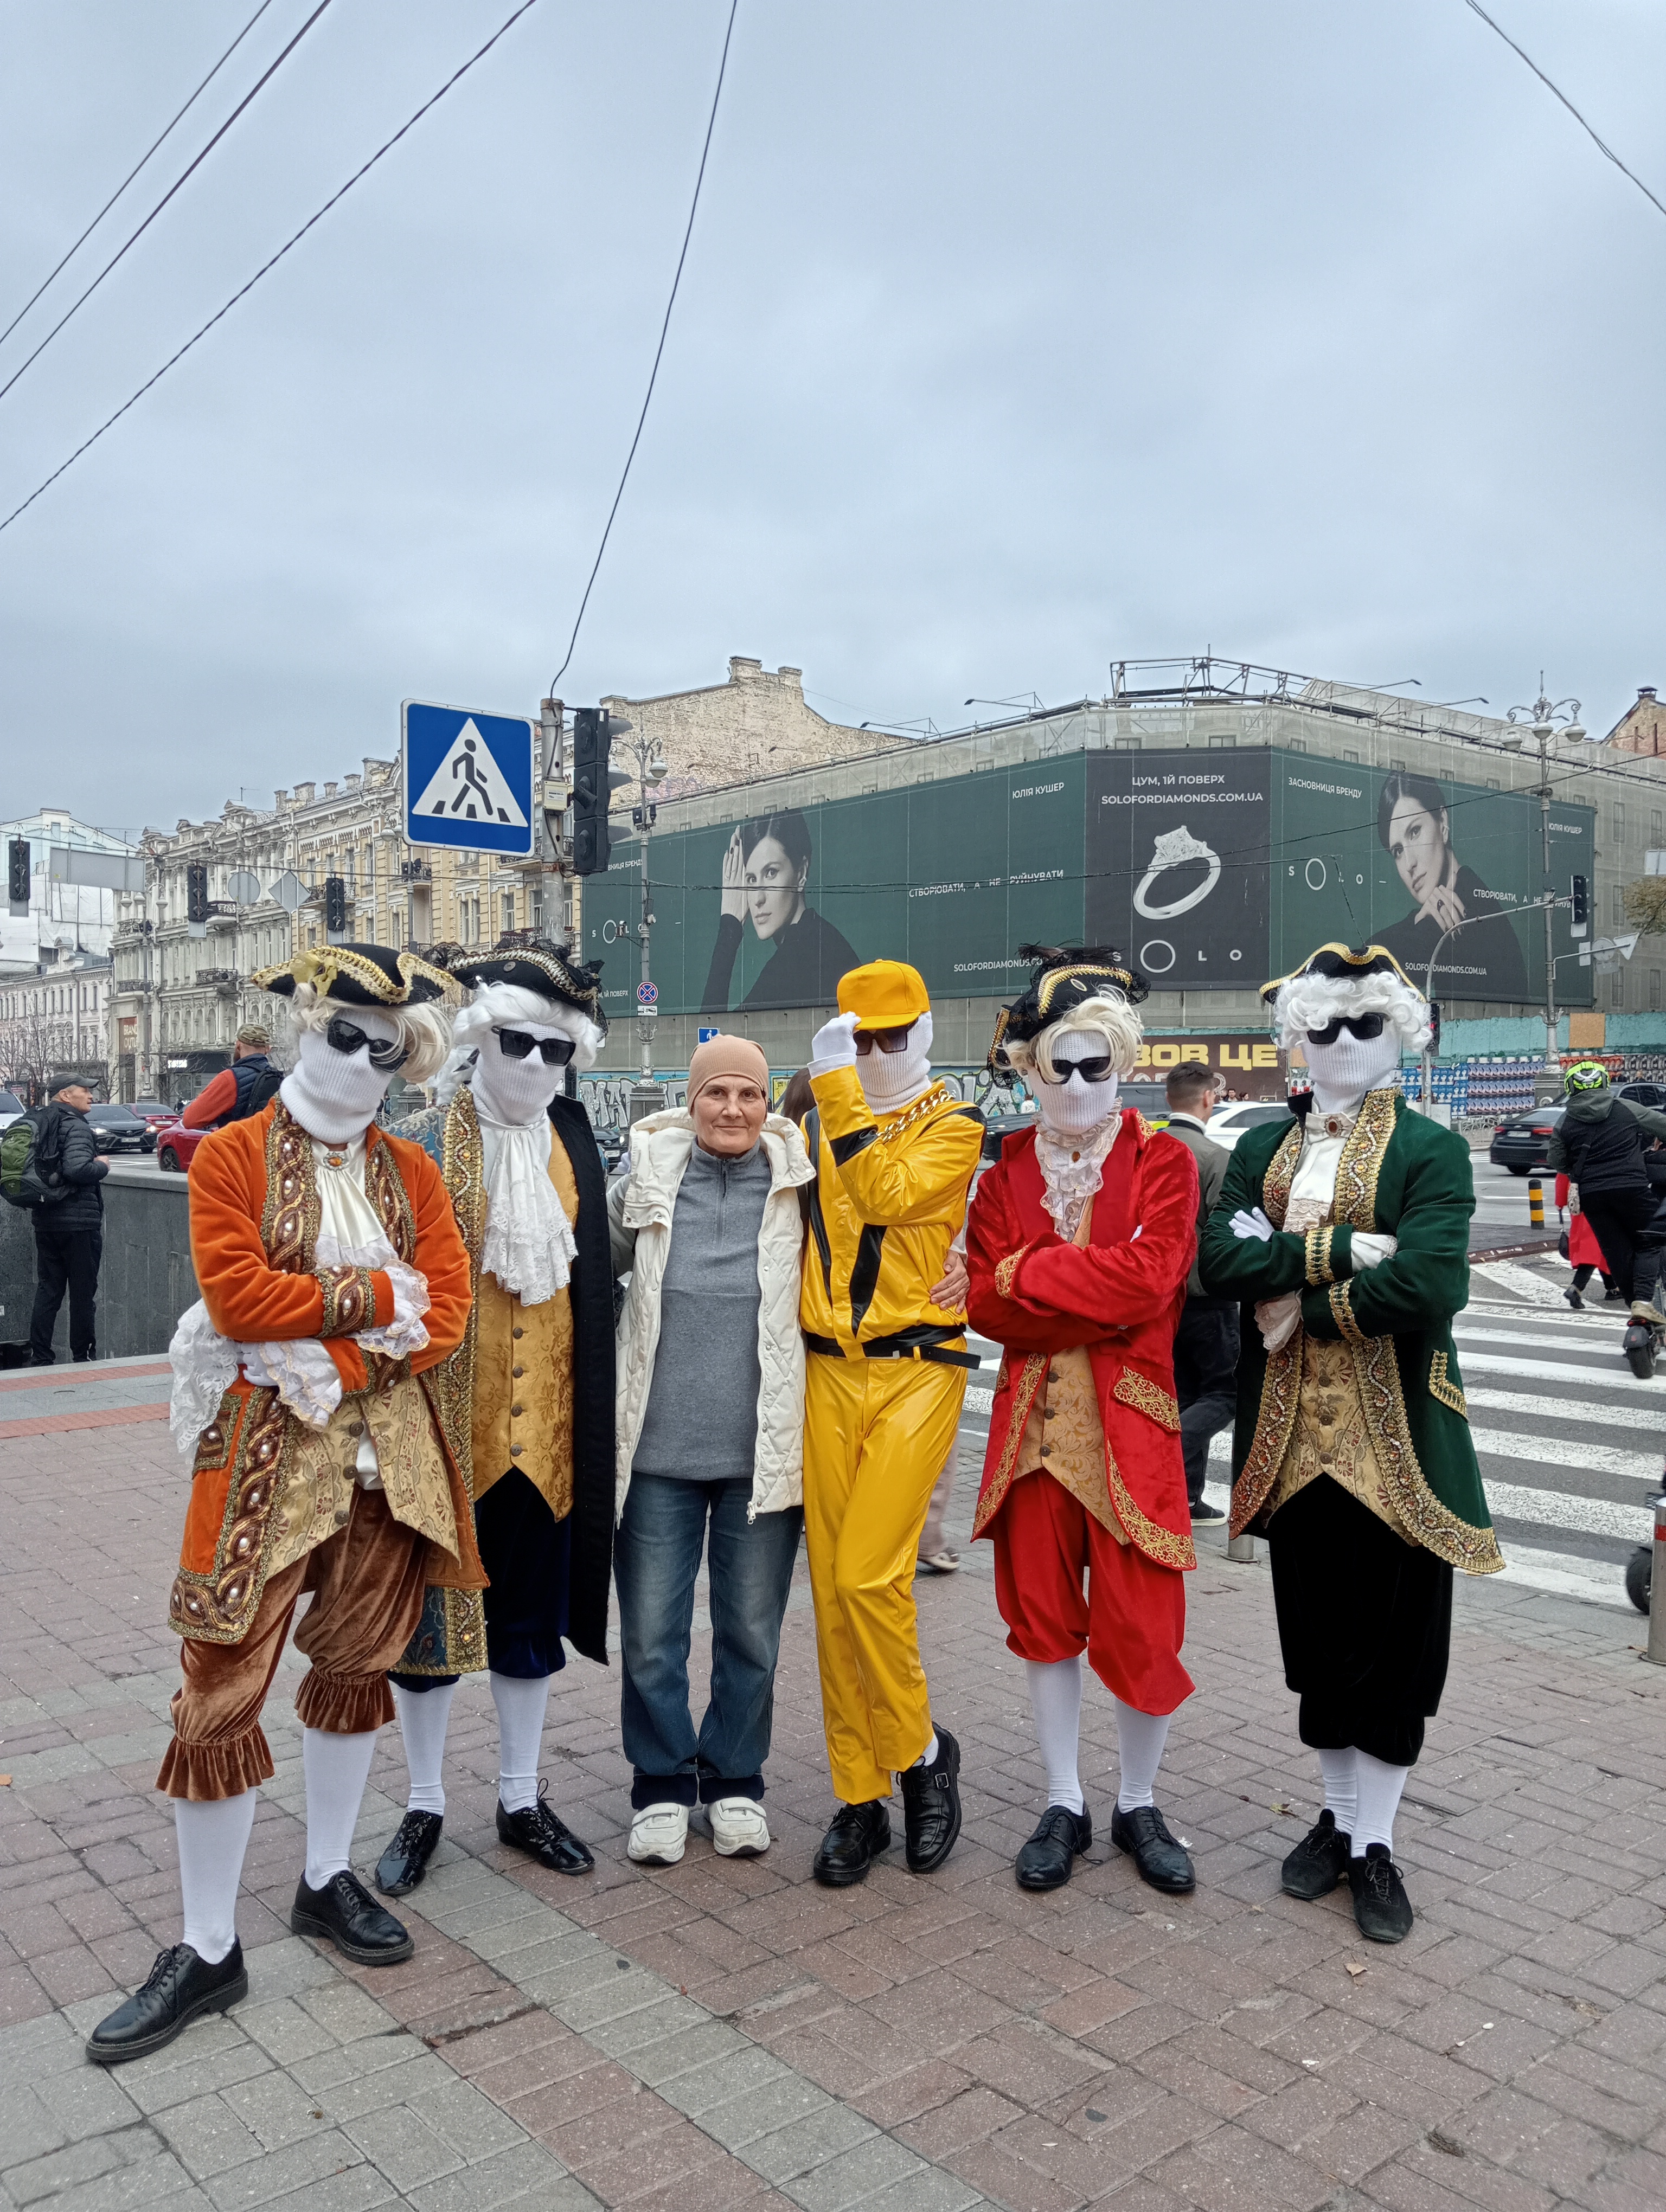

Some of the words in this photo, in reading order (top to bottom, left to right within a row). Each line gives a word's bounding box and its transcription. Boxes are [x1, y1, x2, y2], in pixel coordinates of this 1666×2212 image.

[1132, 776, 1161, 787] ЦУМ,
[1162, 774, 1175, 785] 1Й
[1178, 775, 1225, 785] ПОВЕРХ
[1012, 787, 1033, 799] ЮЛІЯ
[1035, 782, 1065, 795] КУШЕР
[1288, 777, 1335, 794] ЗАСНОВНИЦЯ
[1336, 786, 1362, 799] БРЕНДУ
[1101, 793, 1264, 805] SOLOFORDIAMONDS.COM.UA
[607, 862, 624, 871] ВНИЦЯ
[1473, 889, 1517, 904] СТВОРЮВАТИ,
[1522, 895, 1528, 903] А
[953, 957, 1042, 972] SOLOFORDIAMONDS.CO
[1405, 962, 1487, 975] SOLOFODIAMONDS.COM.UA
[124, 1024, 137, 1036] BRAN
[124, 1037, 137, 1048] OUTL
[1219, 1044, 1278, 1071] ЦЕ
